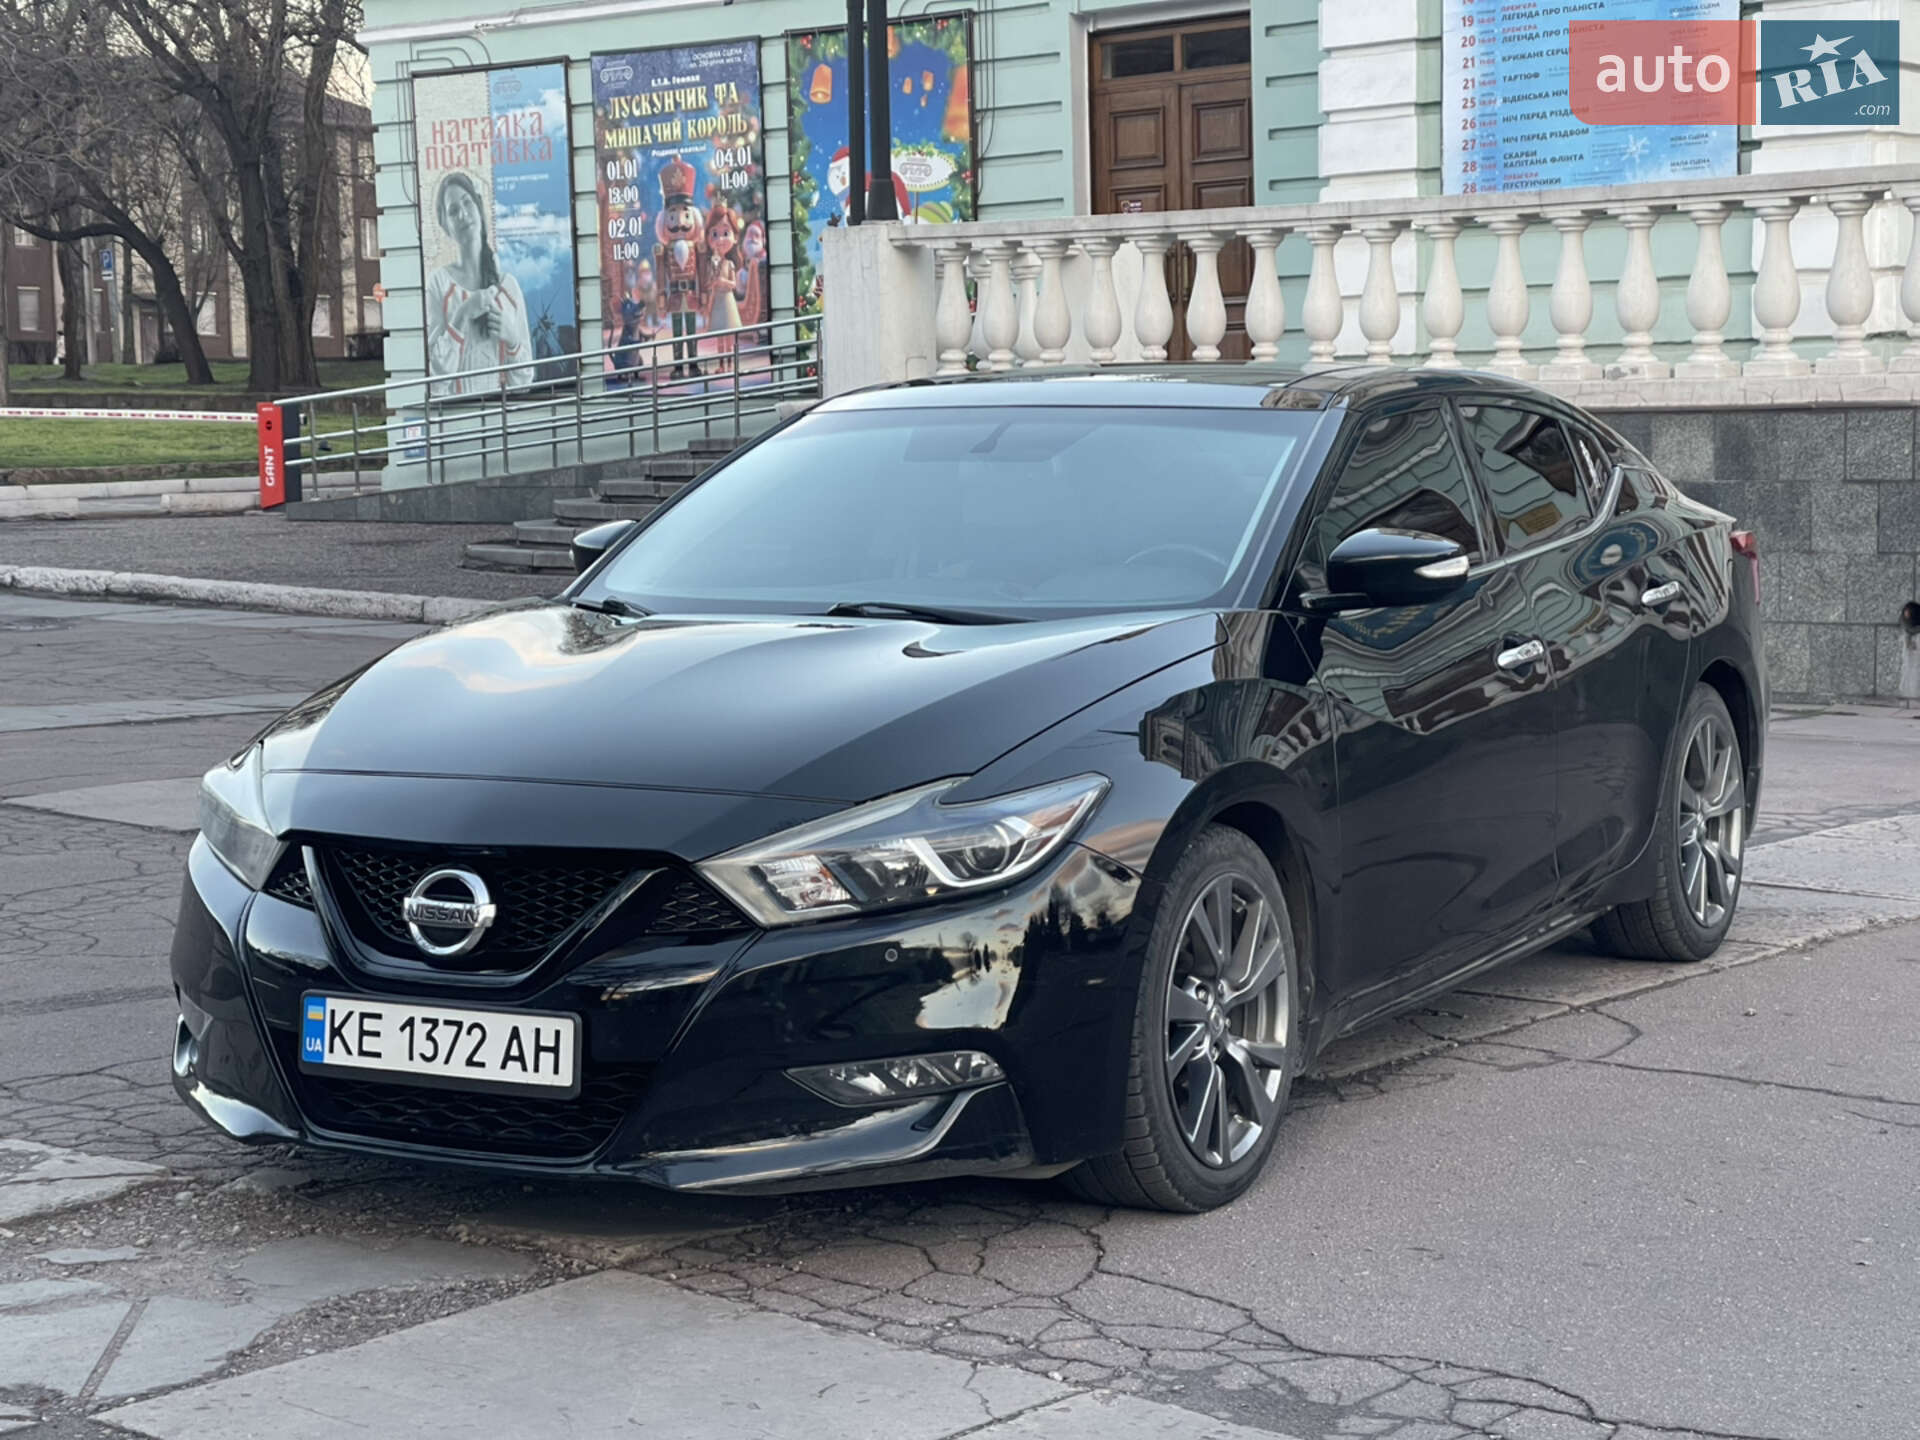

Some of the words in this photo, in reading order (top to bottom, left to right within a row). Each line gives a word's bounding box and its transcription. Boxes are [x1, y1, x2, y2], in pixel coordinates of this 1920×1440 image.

[1501, 10, 1540, 22] ЛЕГЕНДА
[1542, 8, 1561, 16] ПРО
[1563, 2, 1605, 13] ПІАНІСТА
[1461, 16, 1474, 27] 19
[1461, 35, 1476, 48] 20
[1502, 32, 1540, 44] ЛЕГЕНДА
[1542, 29, 1561, 37] ПРО
[1462, 57, 1476, 69] 21
[1502, 49, 1544, 62] КРИЖАНЕ
[1462, 78, 1476, 90] 21
[1503, 72, 1540, 83] ТАРТЮФ
[608, 86, 708, 120] ЛУСКУНЧИК
[1462, 97, 1476, 109] 25
[1502, 92, 1549, 104] ВІДЕНСЬКА
[1461, 117, 1477, 130] 26
[1502, 115, 1518, 123] НІЧ
[1519, 111, 1548, 121] ПЕРЕД
[431, 111, 543, 145] НАТАЛКА
[604, 118, 682, 149] МИШАЧИЙ
[687, 112, 748, 139] КОРОЛЬ
[1502, 136, 1518, 144] НІЧ
[1519, 132, 1548, 142] ПЕРЕД
[1549, 128, 1590, 138] РІЗДВОМ
[1461, 139, 1476, 151] 27
[425, 136, 553, 171] ПОЛТАВКА
[714, 146, 752, 169] 04.01
[1503, 150, 1537, 160] СКАРБИ
[1503, 155, 1548, 169] КАПІТАНА
[1549, 153, 1584, 163] ФЛІНТА
[606, 159, 638, 181] 01.01
[1462, 161, 1477, 173] 28
[721, 170, 748, 190] 11:00
[1502, 178, 1561, 190] ПУСТУНЧИКИ
[1462, 183, 1477, 194] 28
[607, 216, 643, 239] 02.01
[613, 242, 640, 261] 11:00
[264, 445, 275, 487] GANT
[406, 902, 481, 924] NISSAN
[305, 1036, 323, 1052] UA
[327, 1008, 383, 1059] KE
[399, 1015, 488, 1069] 1372
[500, 1025, 561, 1076] AH
